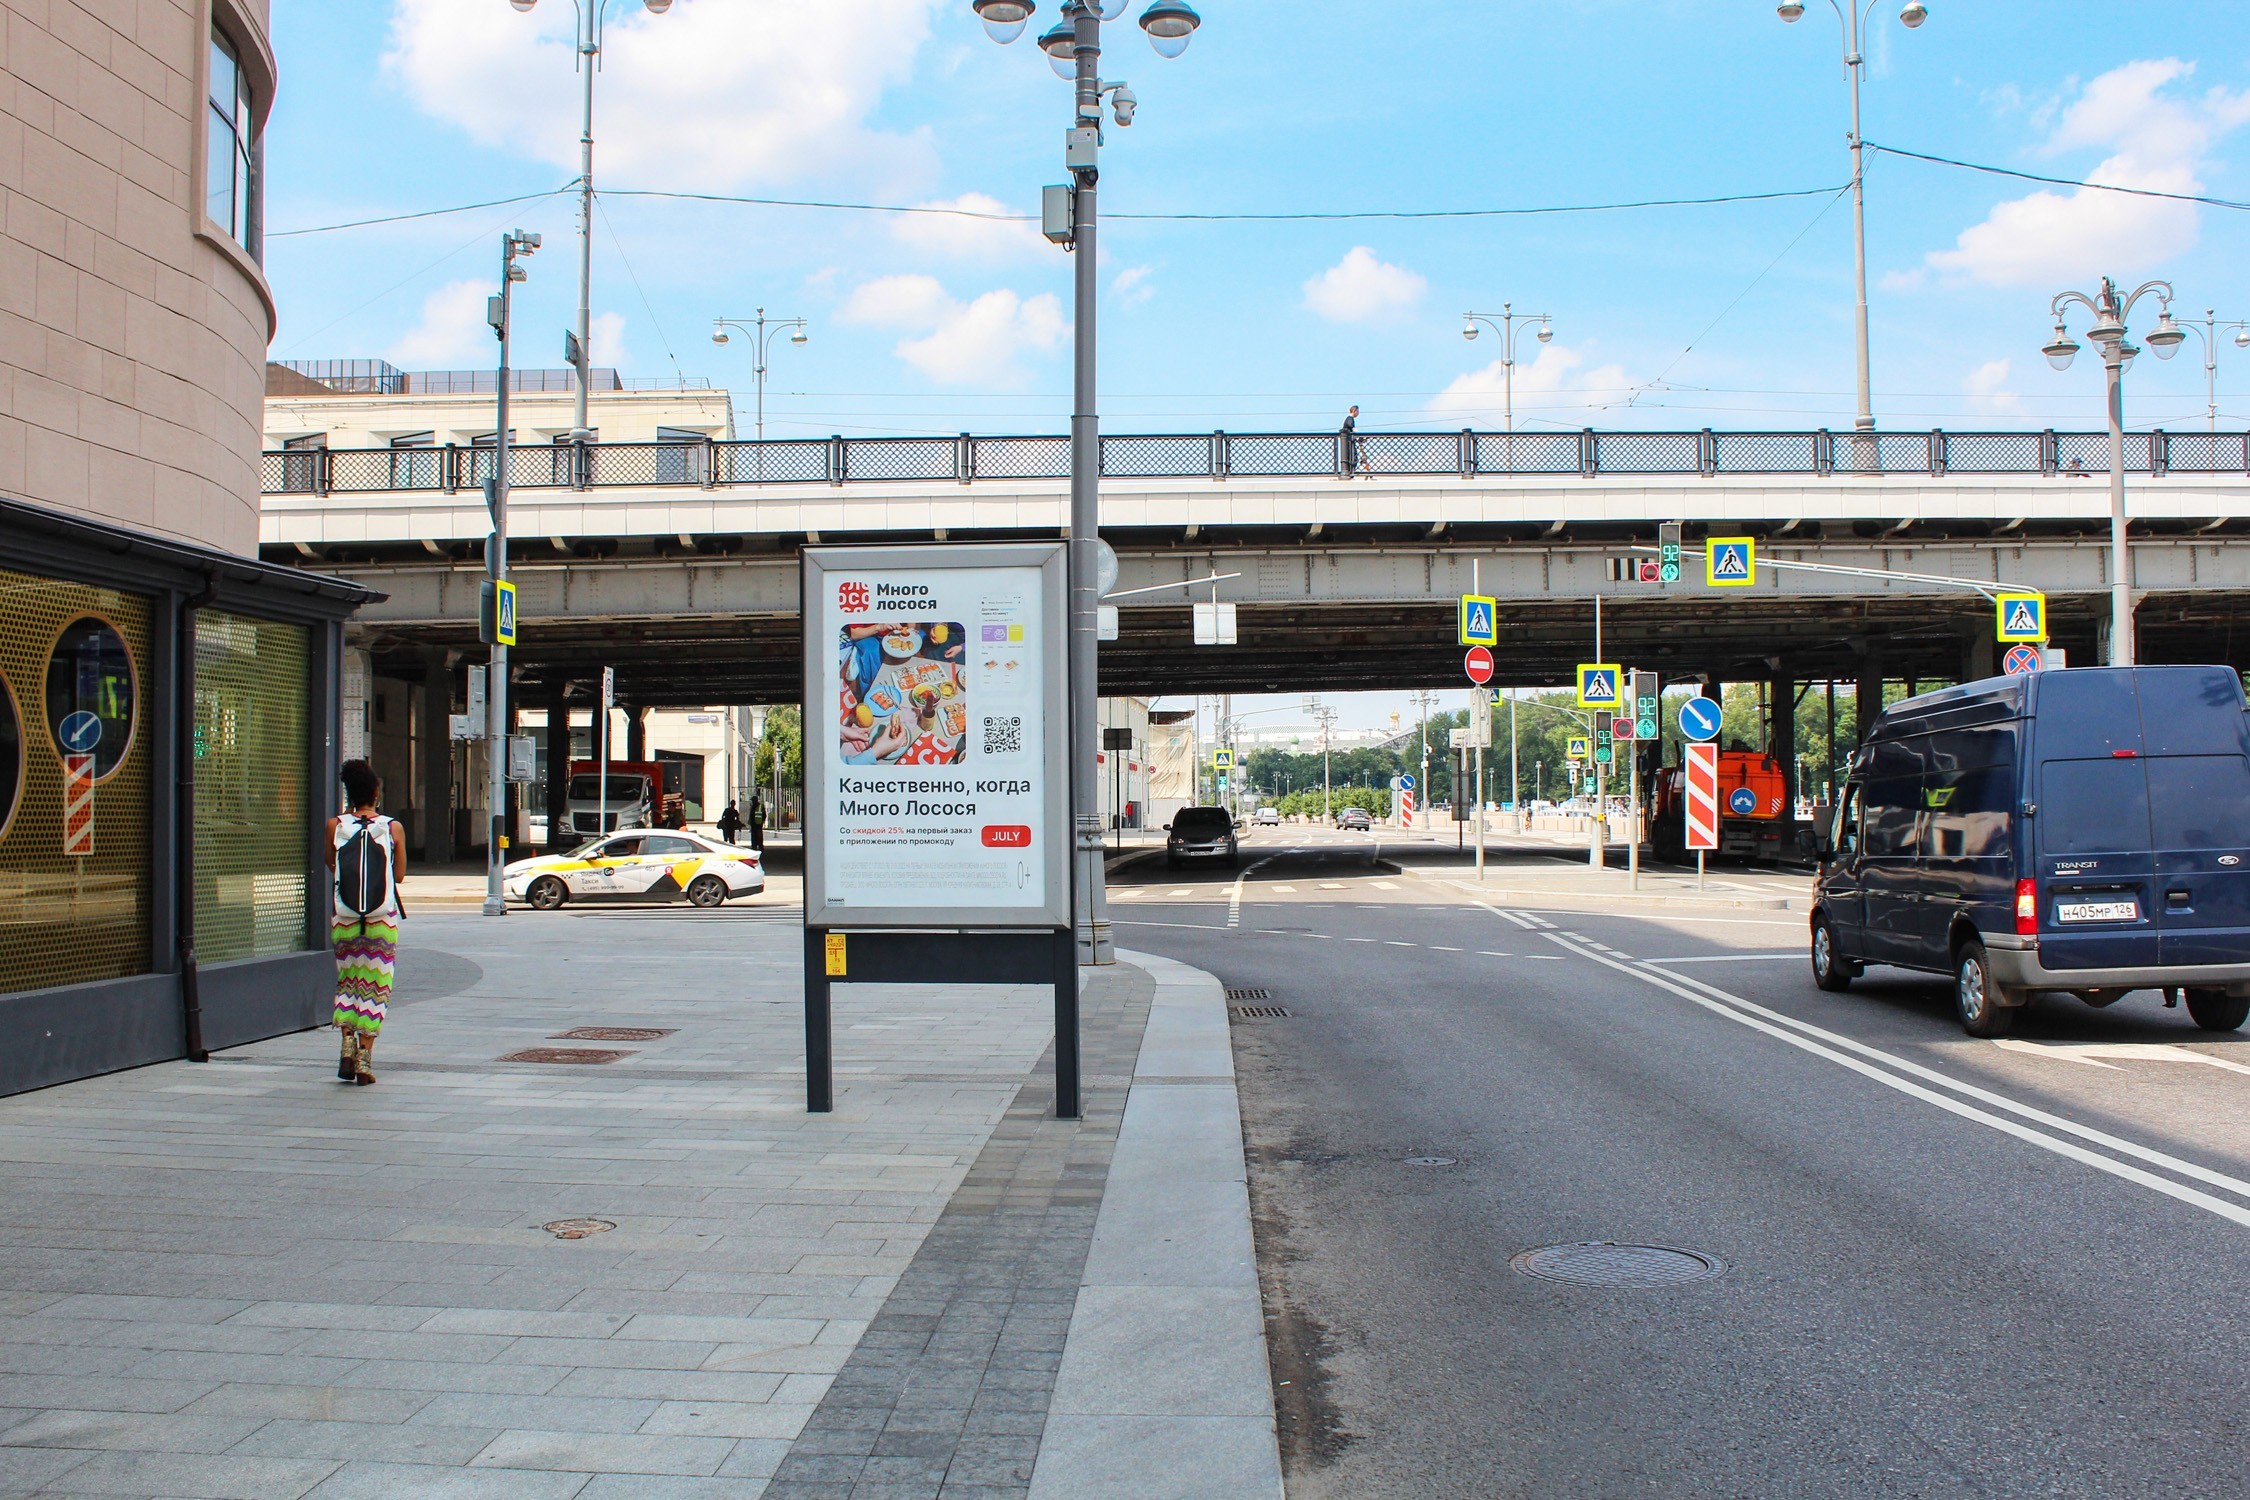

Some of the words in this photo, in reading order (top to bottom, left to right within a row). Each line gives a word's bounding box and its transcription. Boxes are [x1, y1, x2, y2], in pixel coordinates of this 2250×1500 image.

[1663, 545, 1679, 561] 92
[876, 583, 929, 596] Много
[876, 598, 937, 611] лосося
[1638, 697, 1655, 716] 92
[1597, 730, 1611, 745] 92
[839, 777, 971, 796] Качественно,
[976, 779, 1031, 795] когда
[839, 800, 900, 816] Много
[905, 800, 976, 816] Лосося
[839, 826, 851, 835] Со
[852, 826, 886, 836] скидкой
[887, 826, 904, 835] 25%
[917, 826, 949, 837] первый
[991, 831, 1021, 842] JULY
[846, 838, 896, 847] приложении
[909, 838, 955, 847] промокоду
[2054, 860, 2098, 869] TRANSIT
[2063, 905, 2111, 919] Н405МР
[2113, 904, 2132, 914] 126
